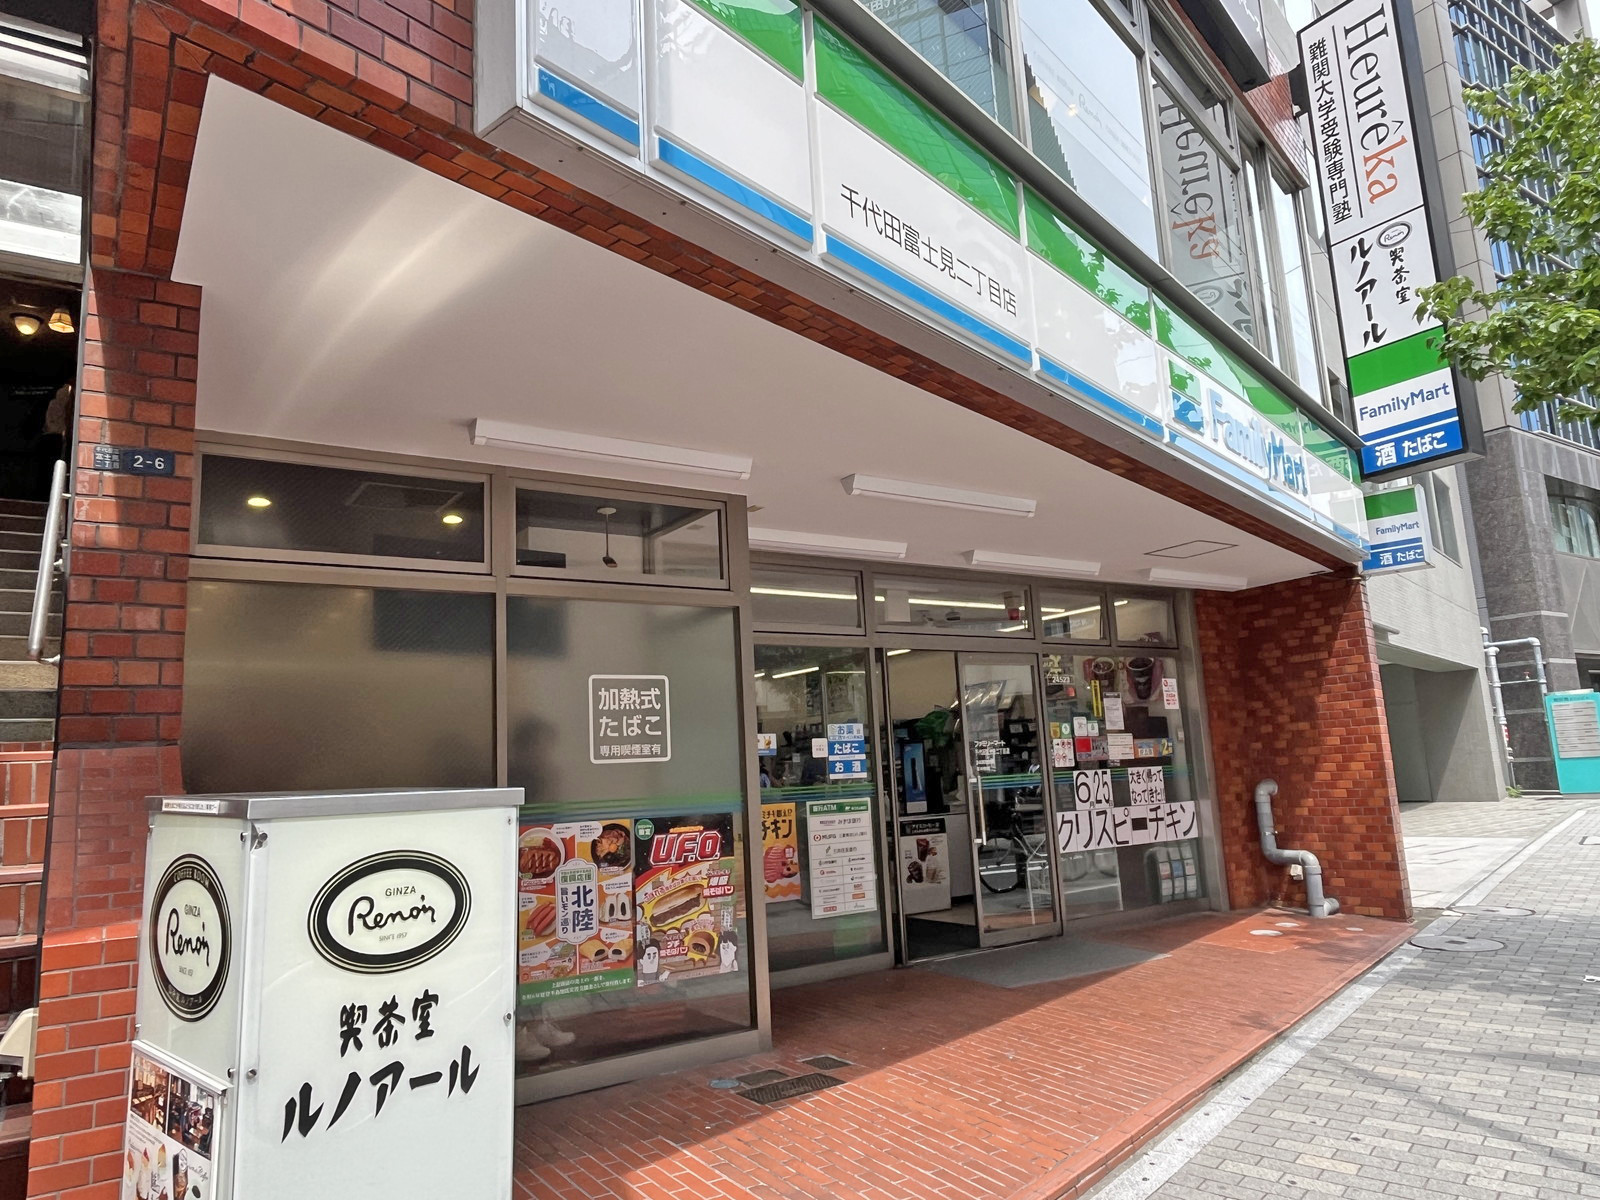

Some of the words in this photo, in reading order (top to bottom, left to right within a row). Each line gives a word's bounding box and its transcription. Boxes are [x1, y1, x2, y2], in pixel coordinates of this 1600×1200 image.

[1309, 37, 1353, 225] 難関大学受験専門塾
[841, 184, 1017, 318] 千代田富士見二丁目店
[1350, 237, 1388, 348] ルノアール
[1388, 246, 1411, 305] 喫茶室
[1359, 382, 1451, 422] FamilyMart
[1208, 388, 1308, 497] FamilyMart
[1375, 442, 1398, 468] 酒
[1402, 430, 1448, 459] たばこ
[133, 455, 165, 470] 2-6
[1375, 521, 1420, 536] FamilyMart
[1380, 552, 1393, 566] 酒
[1397, 549, 1424, 562] たばこ
[599, 687, 662, 711] 加熱式
[599, 715, 662, 738] たばこ
[599, 743, 662, 757] 専用喫煙室有
[833, 743, 860, 755] たばこ
[1058, 804, 1196, 851] クリスピーチキン
[184, 903, 201, 918] GINZA
[385, 885, 416, 897] GINZA
[571, 884, 594, 933] 北陸
[339, 988, 440, 1059] 喫茶室
[281, 1044, 481, 1144] ルノアール
